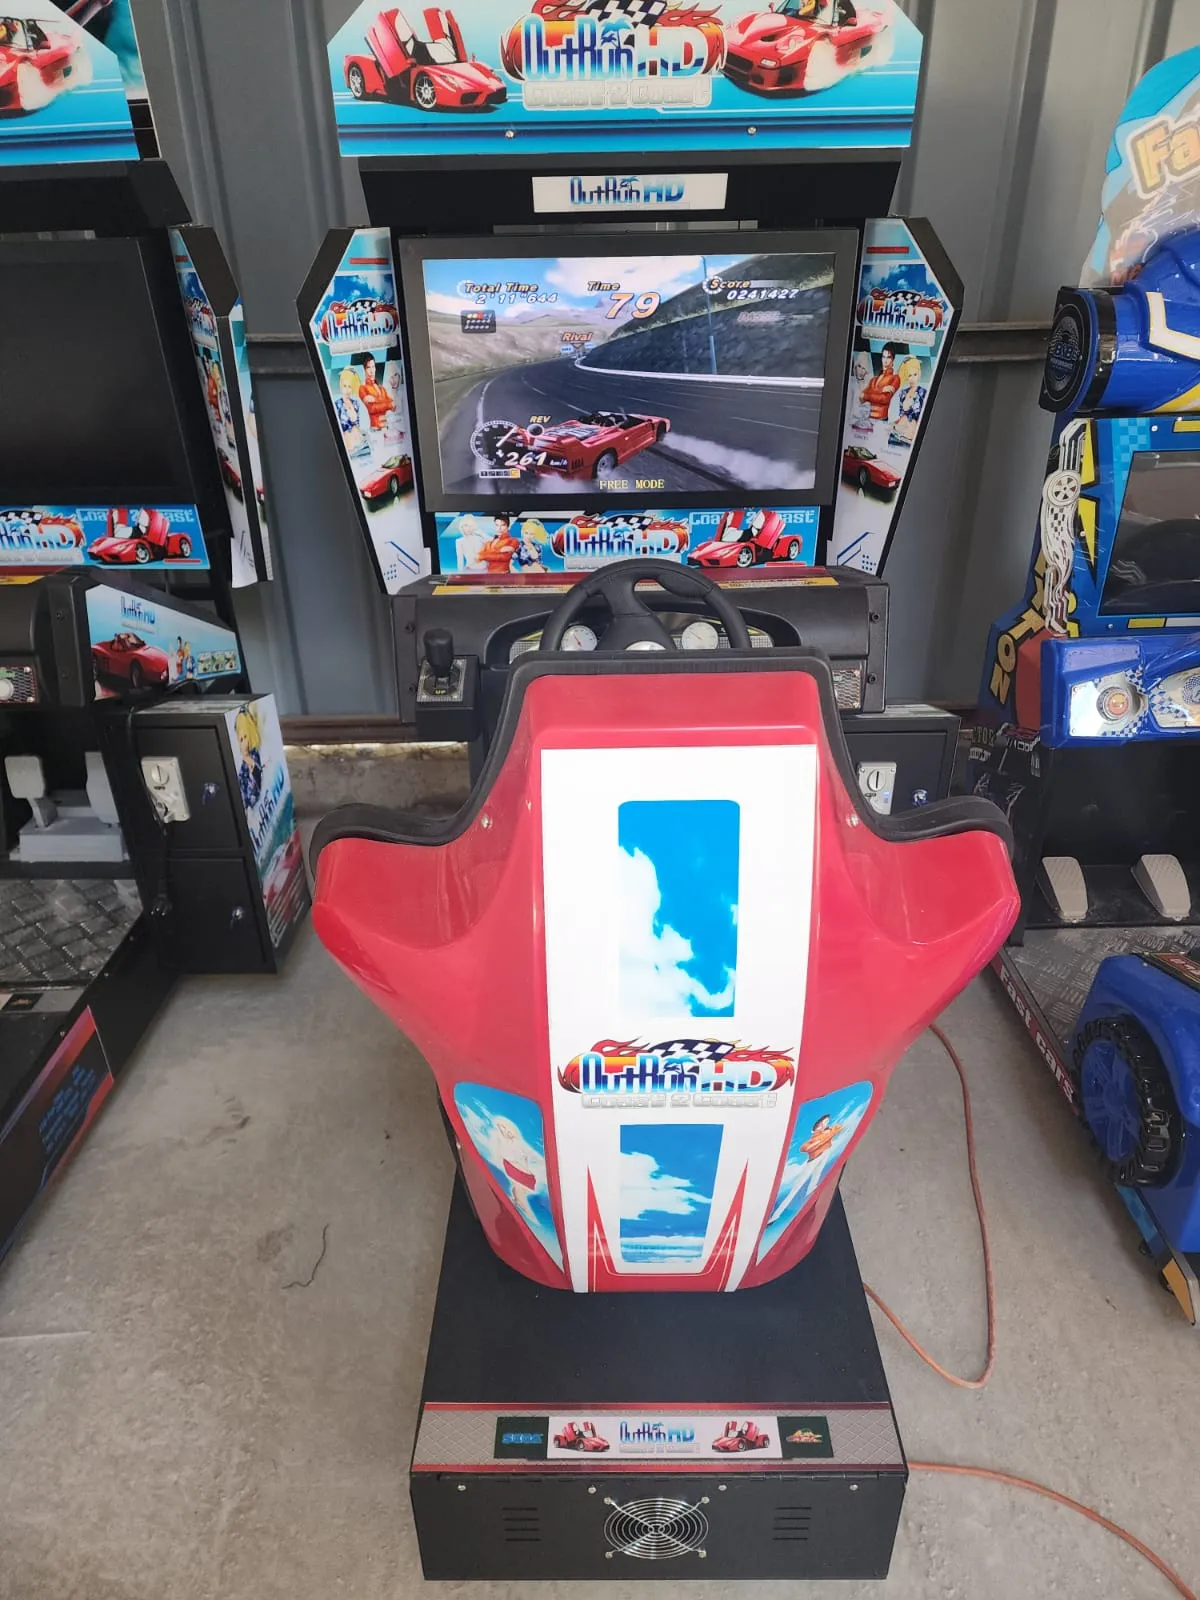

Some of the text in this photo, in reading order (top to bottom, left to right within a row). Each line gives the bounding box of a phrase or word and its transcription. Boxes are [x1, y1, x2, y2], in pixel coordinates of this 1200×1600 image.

[524, 17, 706, 81] OutRun HD
[570, 176, 686, 205] OutRun HD
[465, 282, 539, 294] Total Time
[587, 281, 620, 291] Time
[710, 278, 751, 290] Score
[727, 289, 800, 300] 0241427
[605, 292, 660, 319] 79
[561, 332, 593, 342] Rival
[530, 416, 550, 424] REV
[504, 451, 547, 466] 261
[600, 479, 665, 490] FREE MODE
[565, 524, 679, 556] OutRun HD
[1000, 965, 1033, 1029] Fast
[582, 1053, 775, 1092] OutRun HD
[668, 1427, 695, 1443] HD
